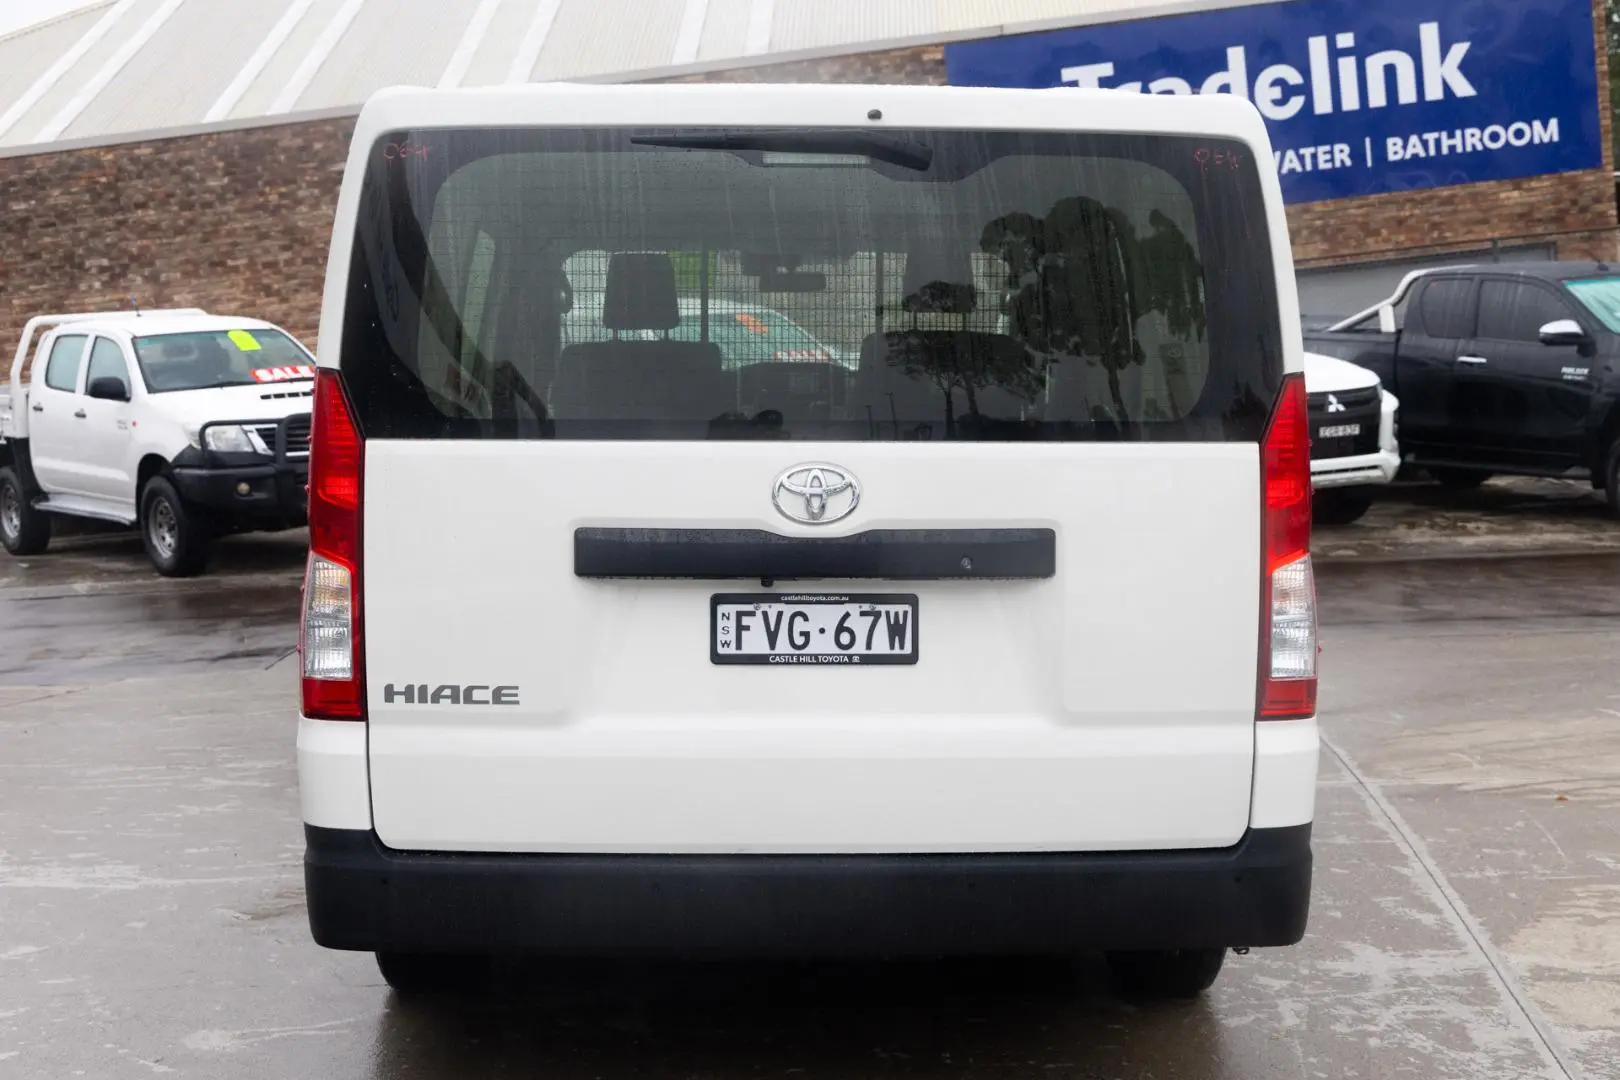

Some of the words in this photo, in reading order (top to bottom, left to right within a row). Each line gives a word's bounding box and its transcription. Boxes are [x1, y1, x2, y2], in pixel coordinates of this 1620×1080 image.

[1061, 22, 1478, 121] Tdelink
[1386, 117, 1560, 162] BATHROOM
[780, 594, 849, 603] castlehilltoyota.com.au
[769, 655, 798, 663] CASTLE
[799, 655, 817, 663] HILL
[817, 655, 849, 663] TOYOTA
[384, 683, 521, 705] HIACE
